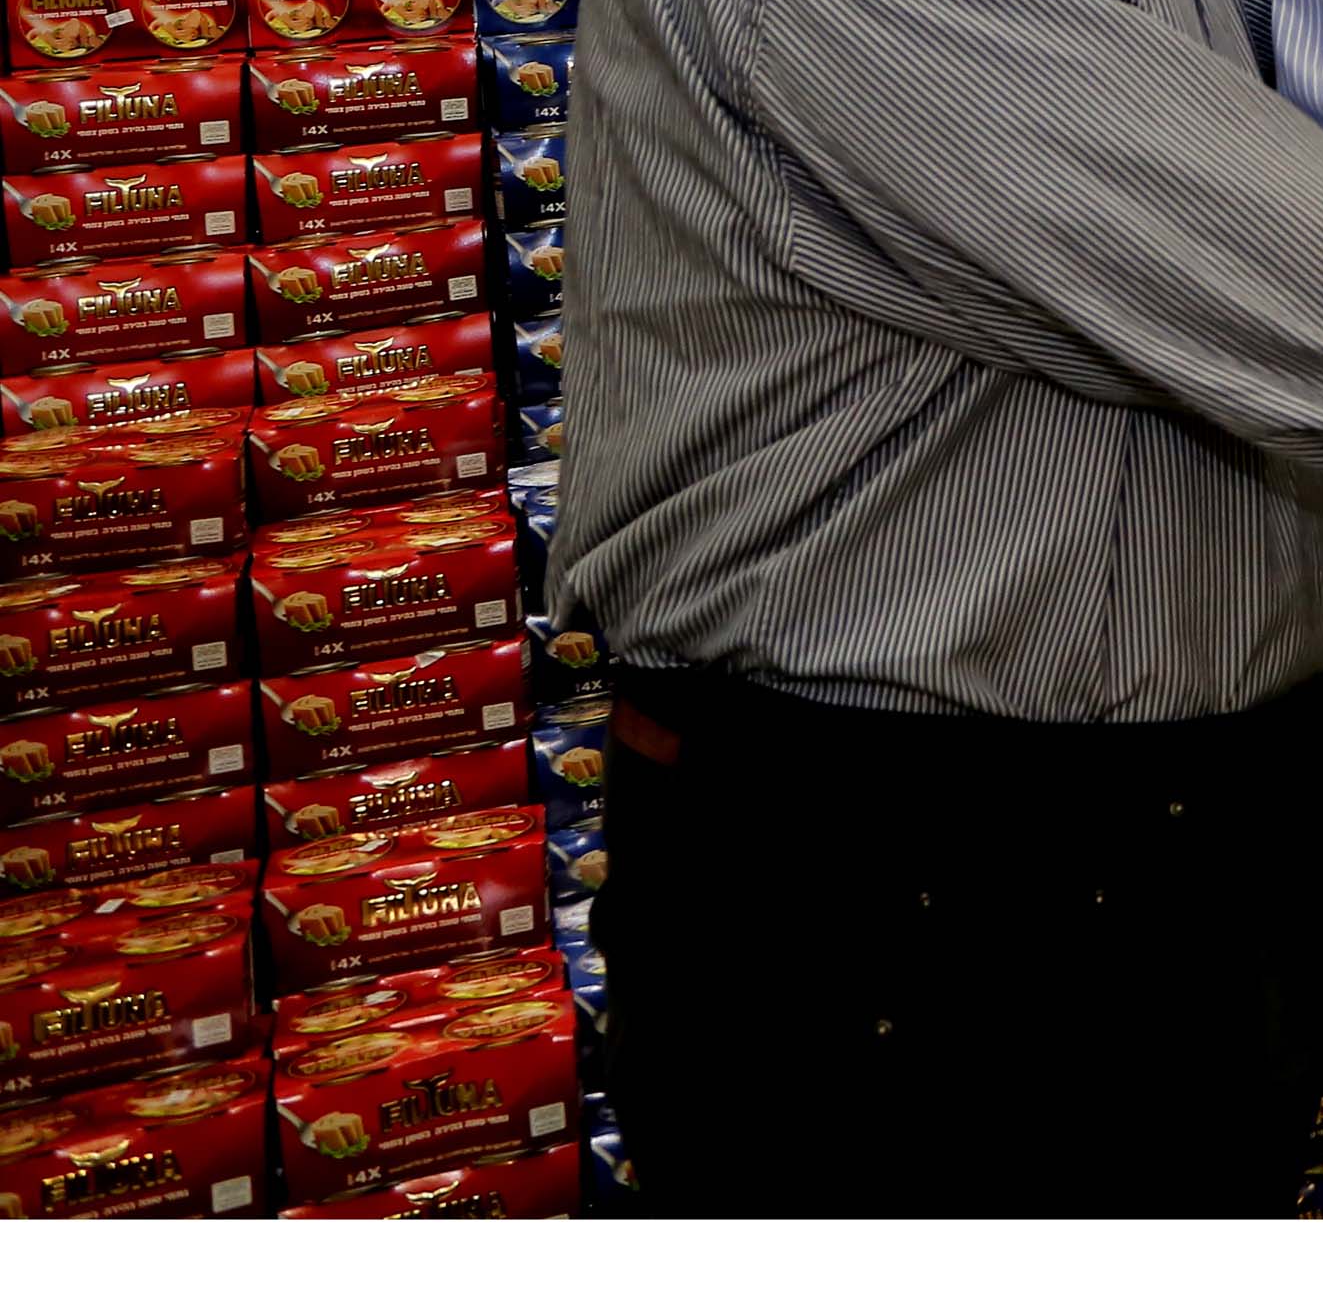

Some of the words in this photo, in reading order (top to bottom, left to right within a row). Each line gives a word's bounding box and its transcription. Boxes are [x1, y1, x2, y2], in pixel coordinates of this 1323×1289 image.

[79, 82, 179, 125] FILTUNA
[83, 173, 185, 217] FILTUNA
[77, 277, 183, 322] FILTUNA
